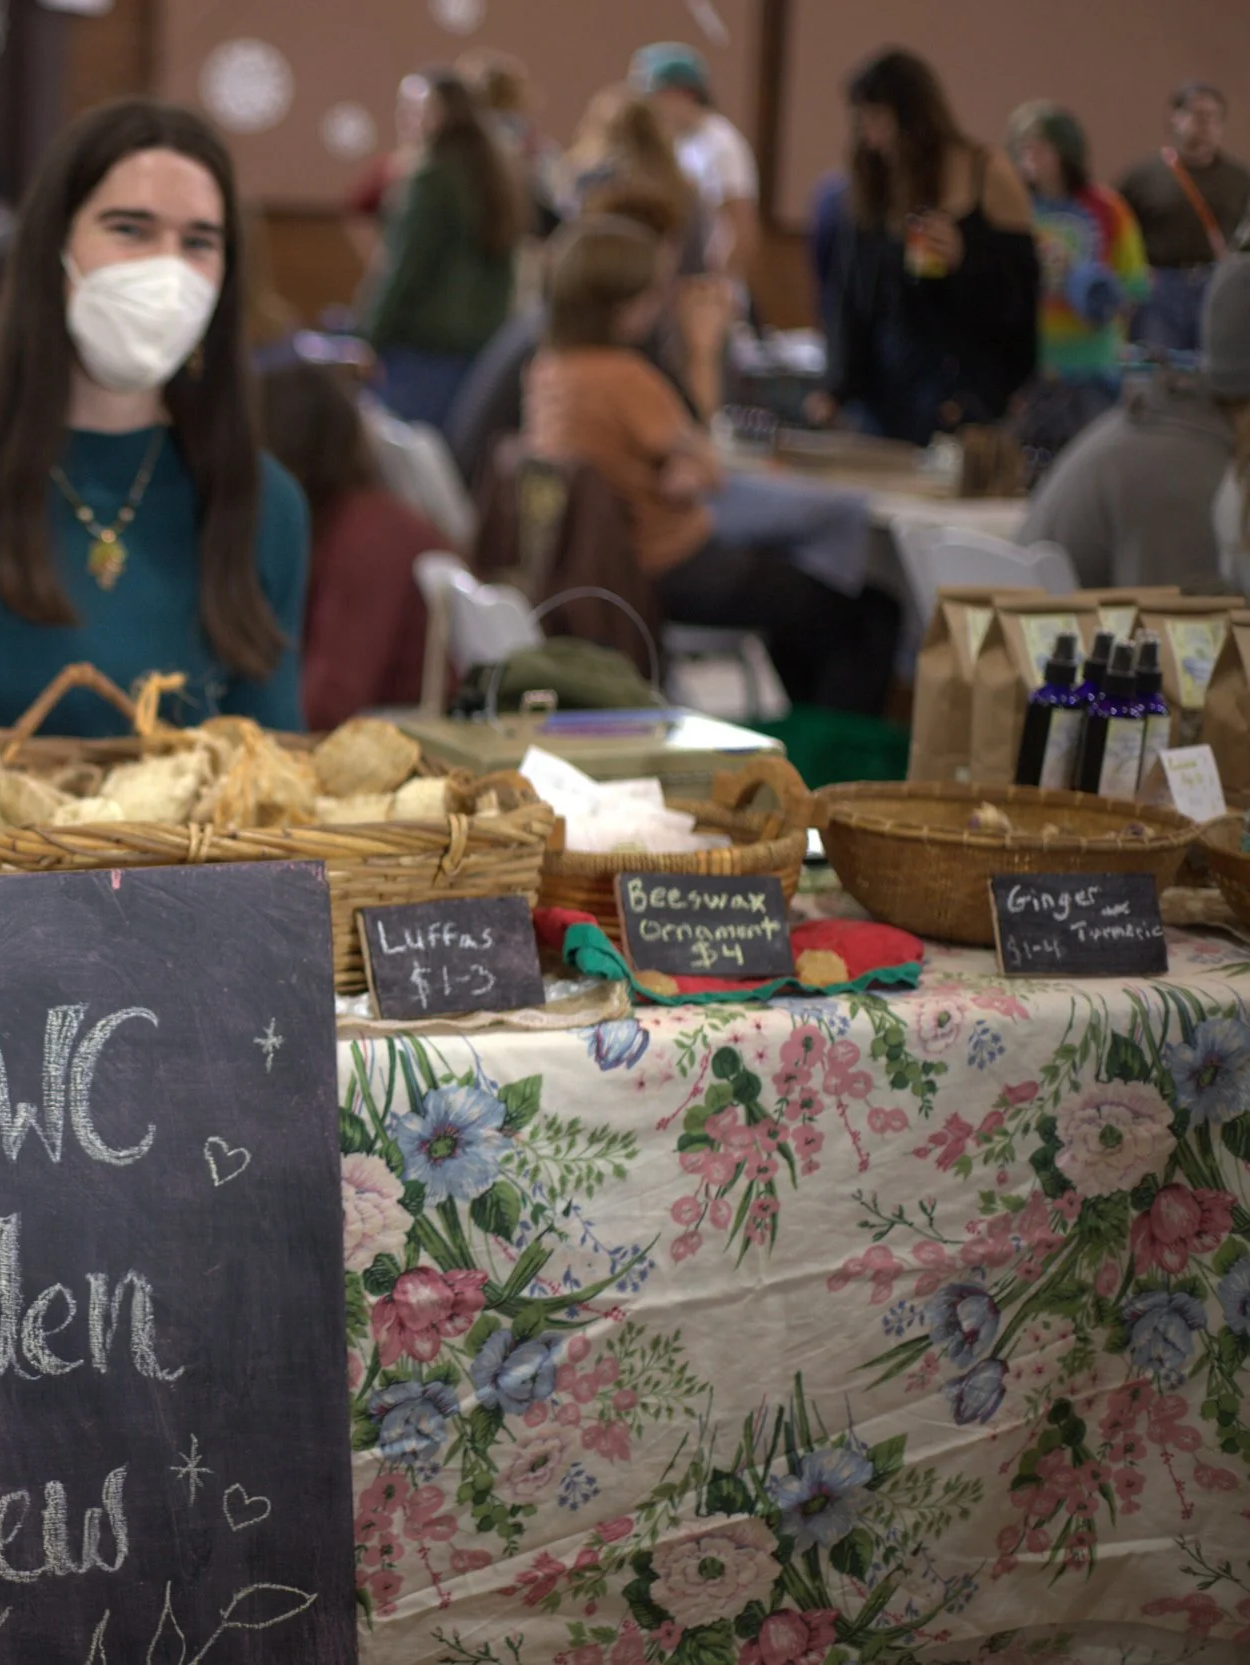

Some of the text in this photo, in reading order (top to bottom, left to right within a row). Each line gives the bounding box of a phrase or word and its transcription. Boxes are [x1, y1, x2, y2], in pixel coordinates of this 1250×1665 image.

[627, 877, 766, 913] Beeswax
[1007, 884, 1100, 921] Ginger
[690, 940, 744, 969] $4
[410, 960, 496, 1009] $1-3
